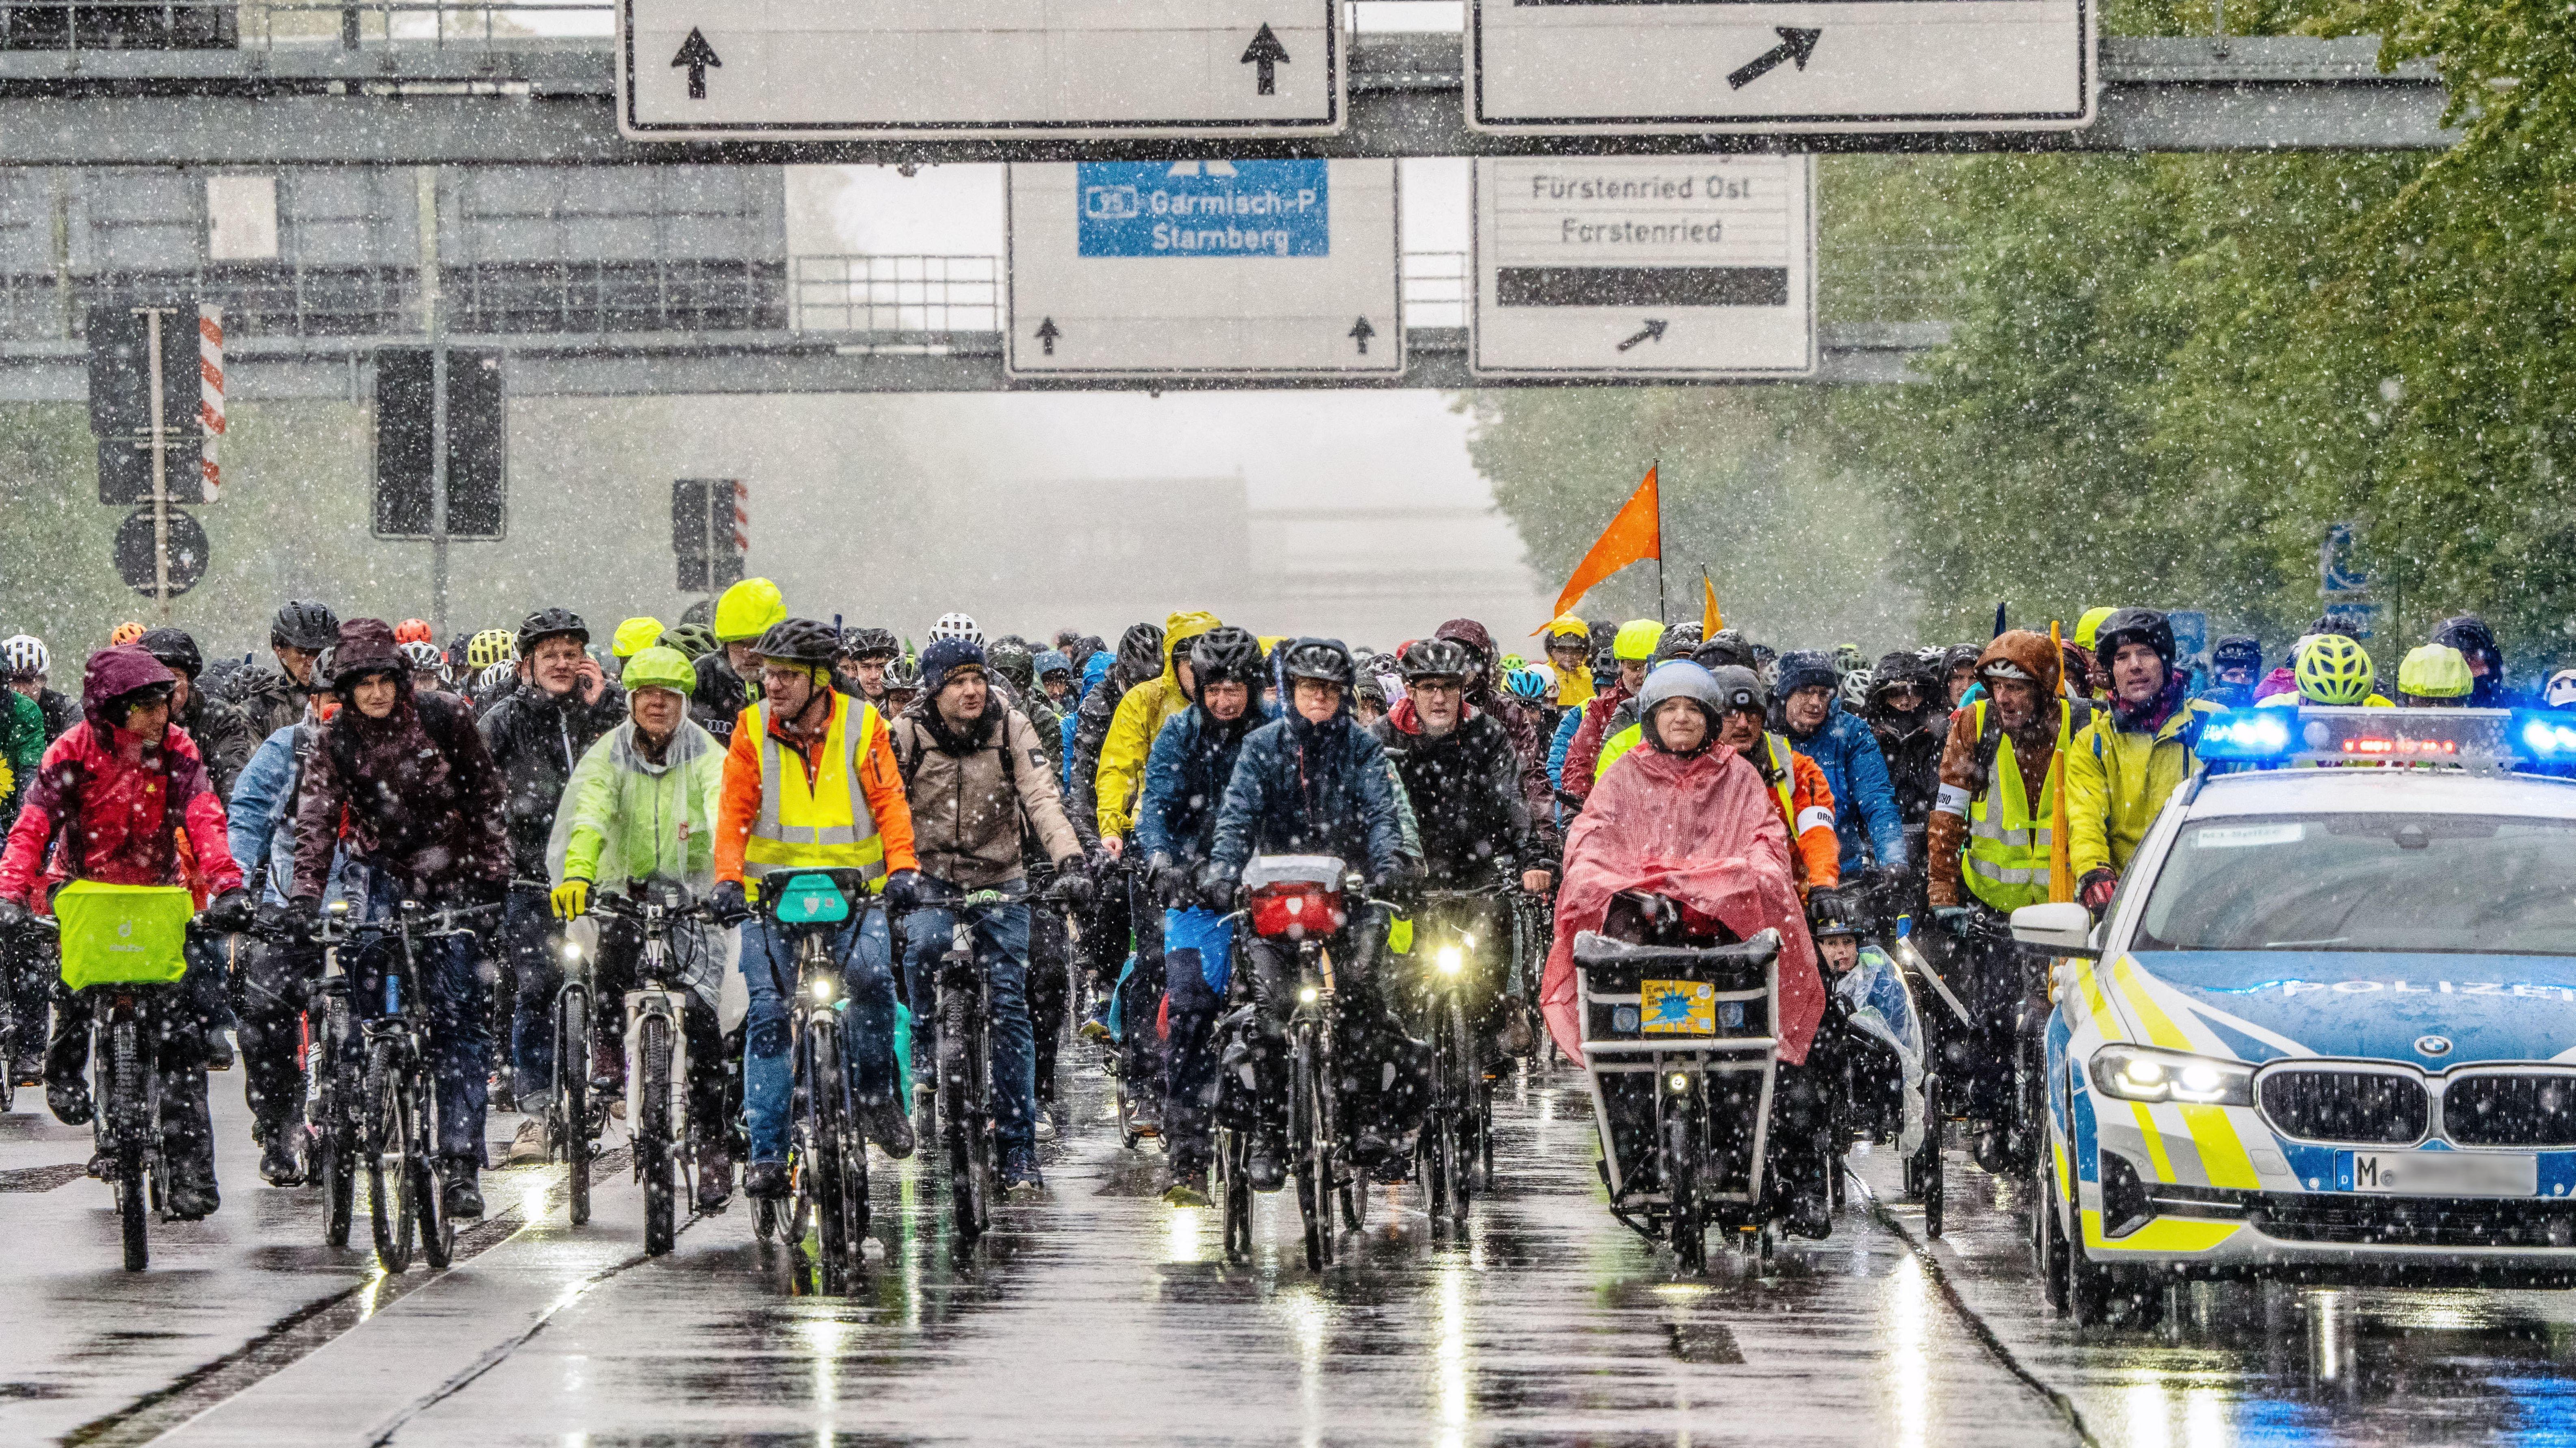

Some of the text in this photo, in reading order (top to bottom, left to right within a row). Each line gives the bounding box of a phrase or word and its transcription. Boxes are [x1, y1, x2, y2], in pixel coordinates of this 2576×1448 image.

[1532, 175, 1750, 199] Fürstenried Ost
[1152, 223, 1288, 255] Starnberg
[1562, 217, 1722, 244] Forstenried
[2283, 980, 2574, 1002] POLIZEI
[2341, 1175, 2349, 1184] D
[2357, 1156, 2377, 1186] M
